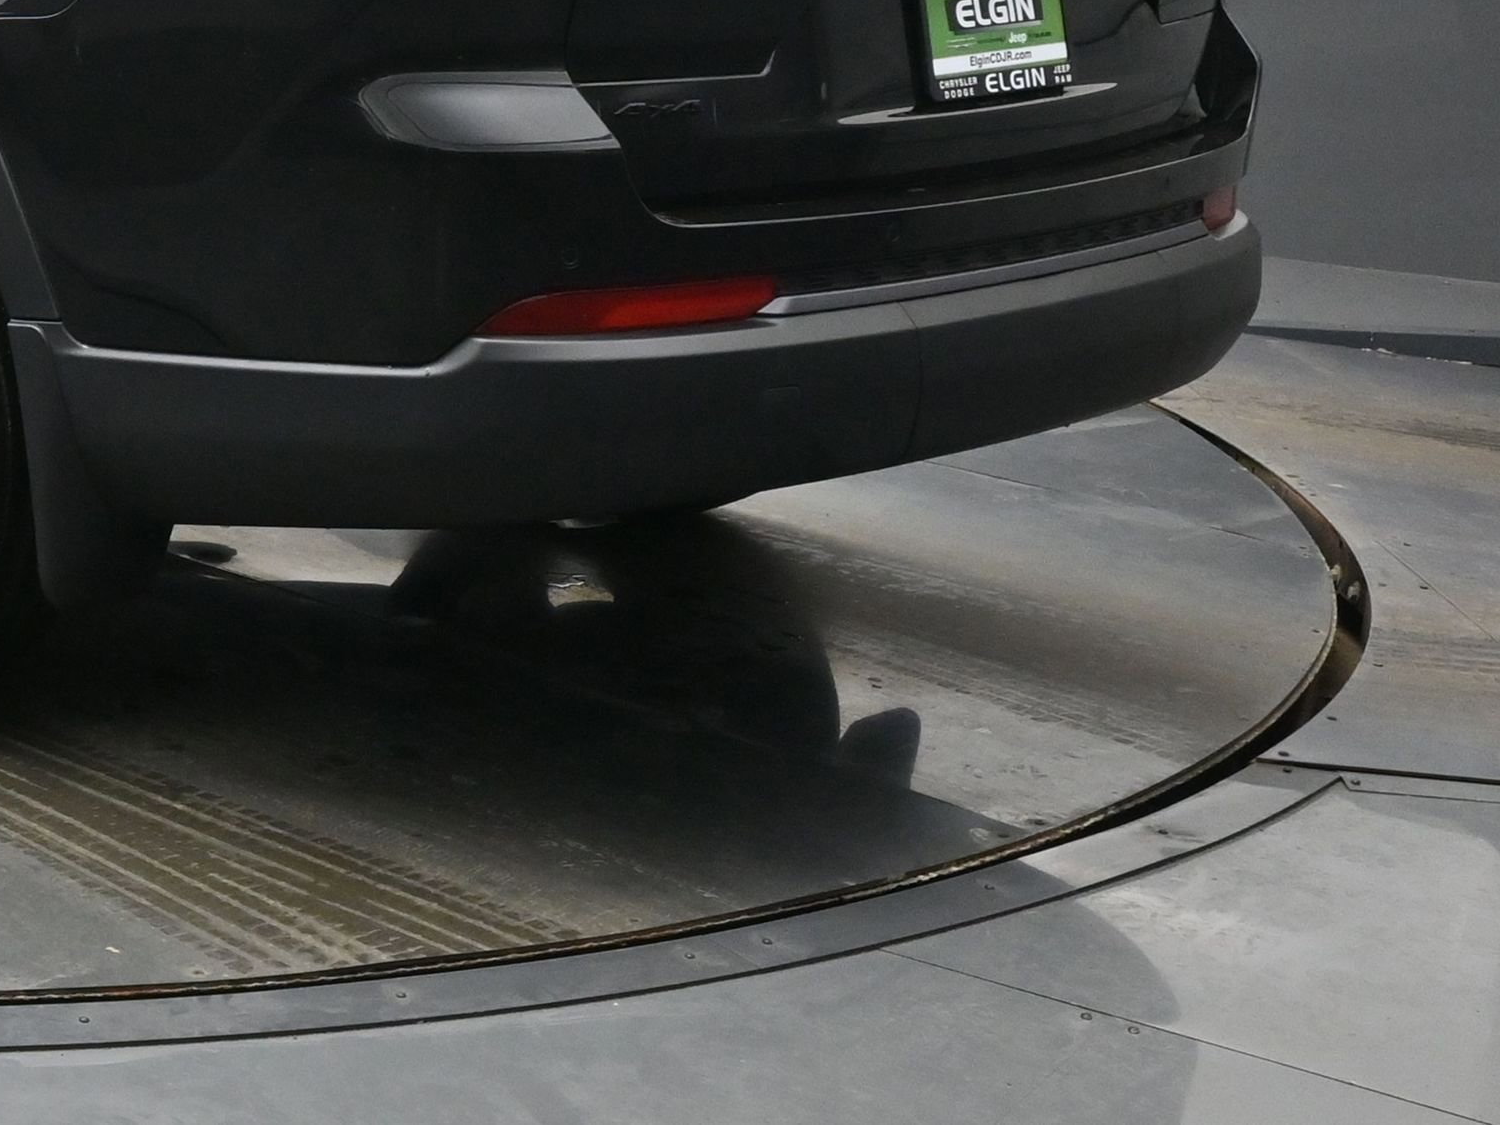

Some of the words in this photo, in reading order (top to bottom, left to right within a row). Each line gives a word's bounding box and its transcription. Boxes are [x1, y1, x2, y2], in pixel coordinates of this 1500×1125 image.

[1008, 31, 1028, 45] Jeep
[969, 50, 1032, 68] ElginCDJR.com
[1053, 64, 1072, 75] JEEP
[938, 76, 978, 90] CHRYSLER
[985, 67, 1047, 93] ELGIN
[944, 87, 975, 100] DODGE
